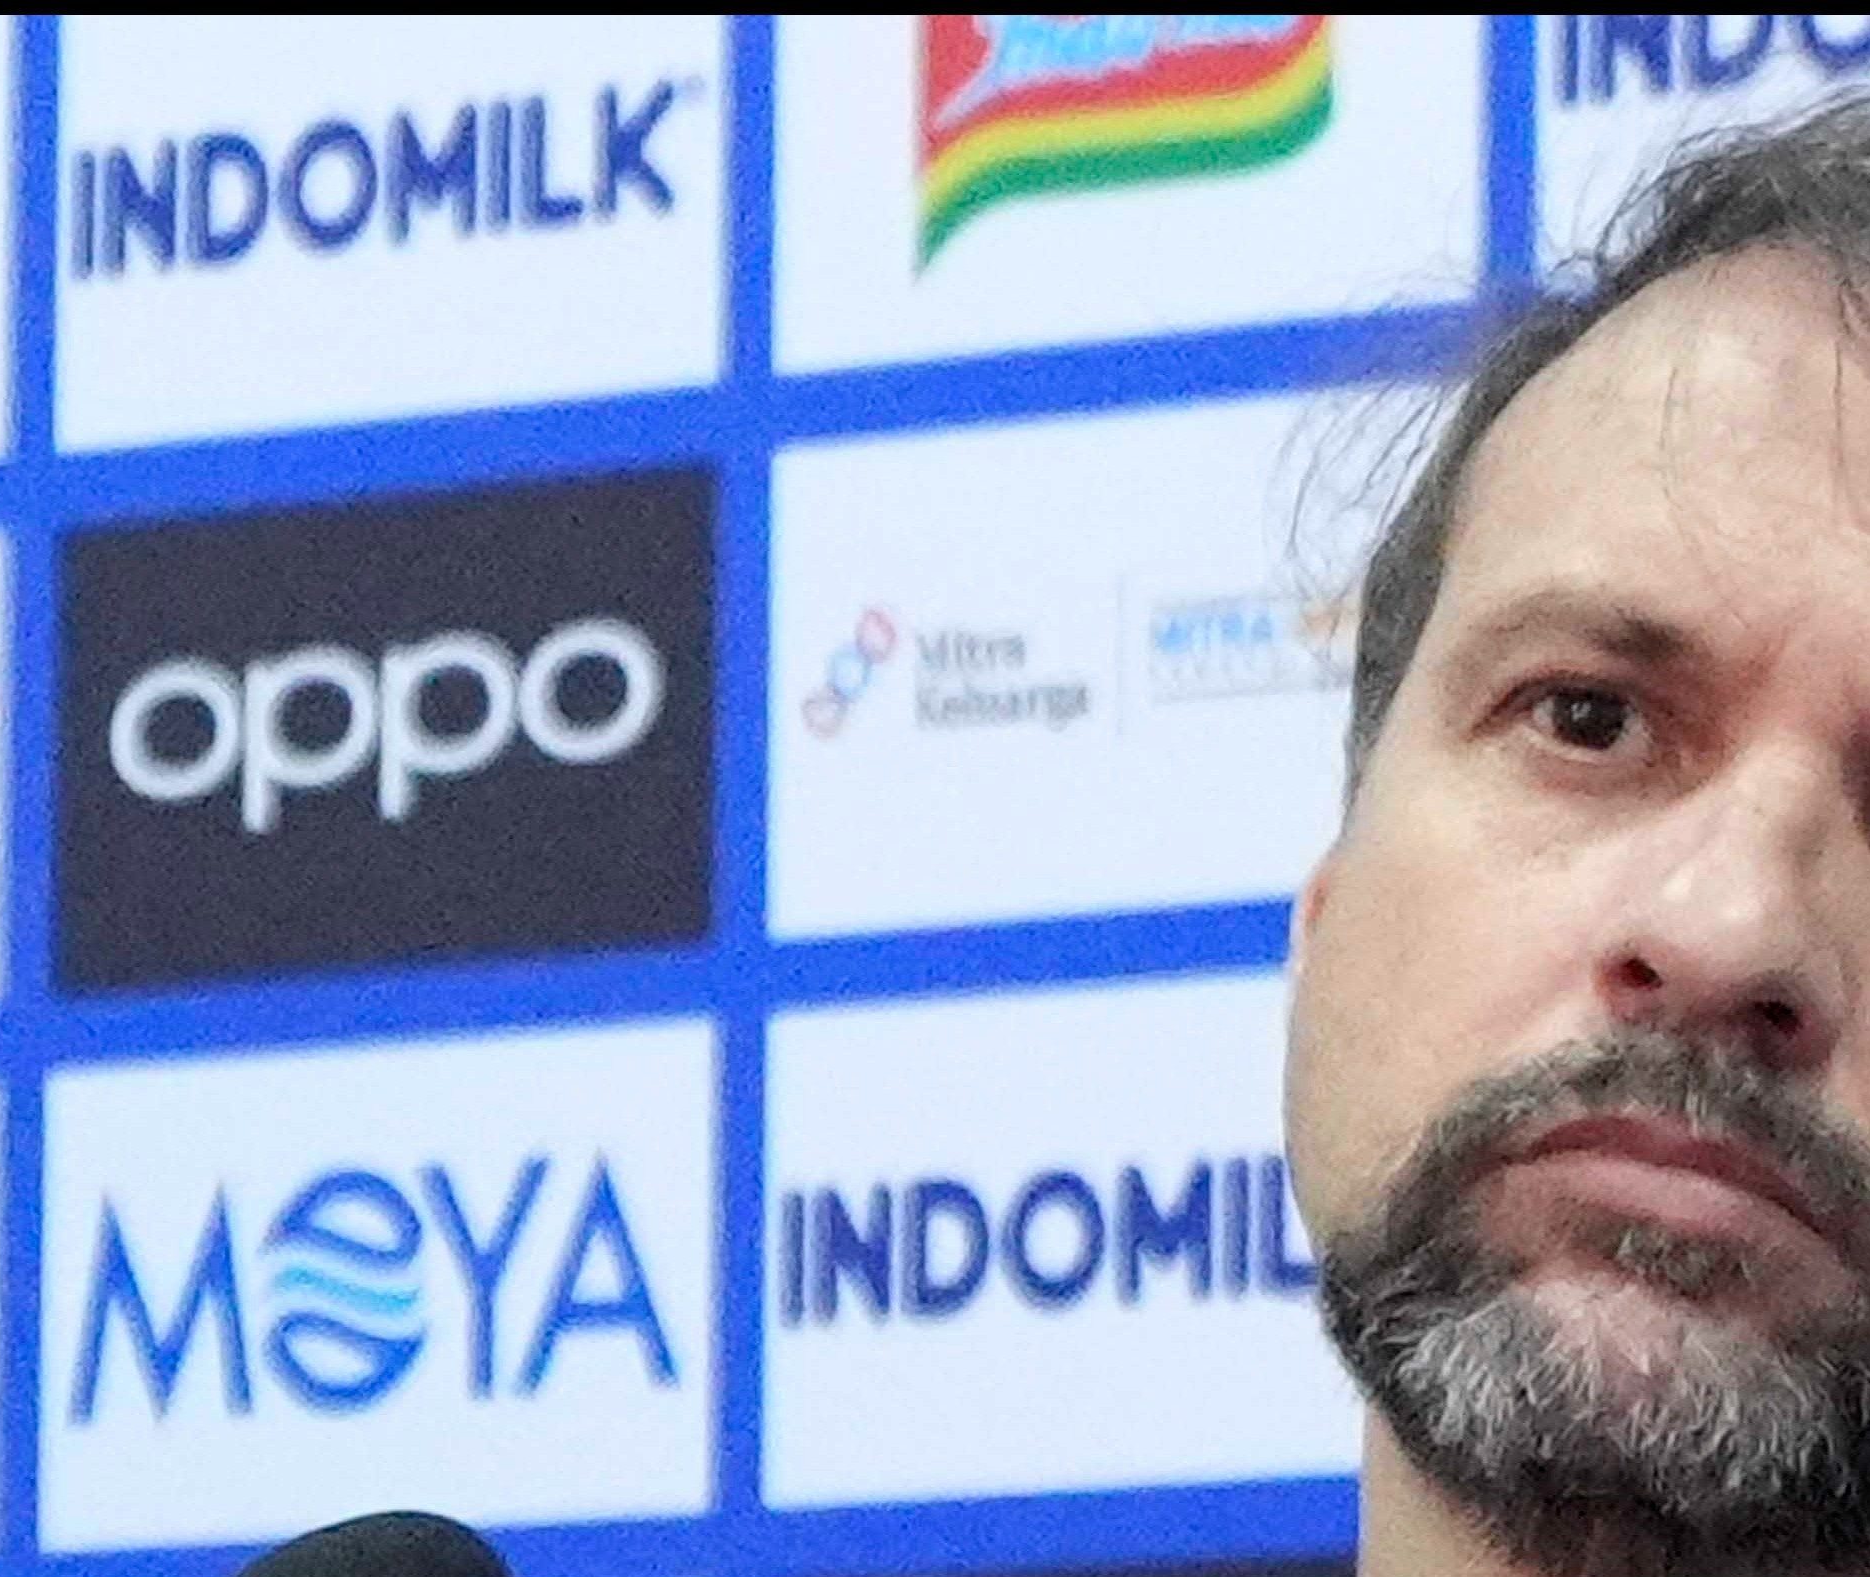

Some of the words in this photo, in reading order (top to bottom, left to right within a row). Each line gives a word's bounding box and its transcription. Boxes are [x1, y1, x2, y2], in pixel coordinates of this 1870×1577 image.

[71, 82, 674, 280] INDOMILK
[108, 615, 666, 836] oppo
[68, 1152, 681, 1424] MOYA
[779, 1150, 1322, 1329] INDOMIL
